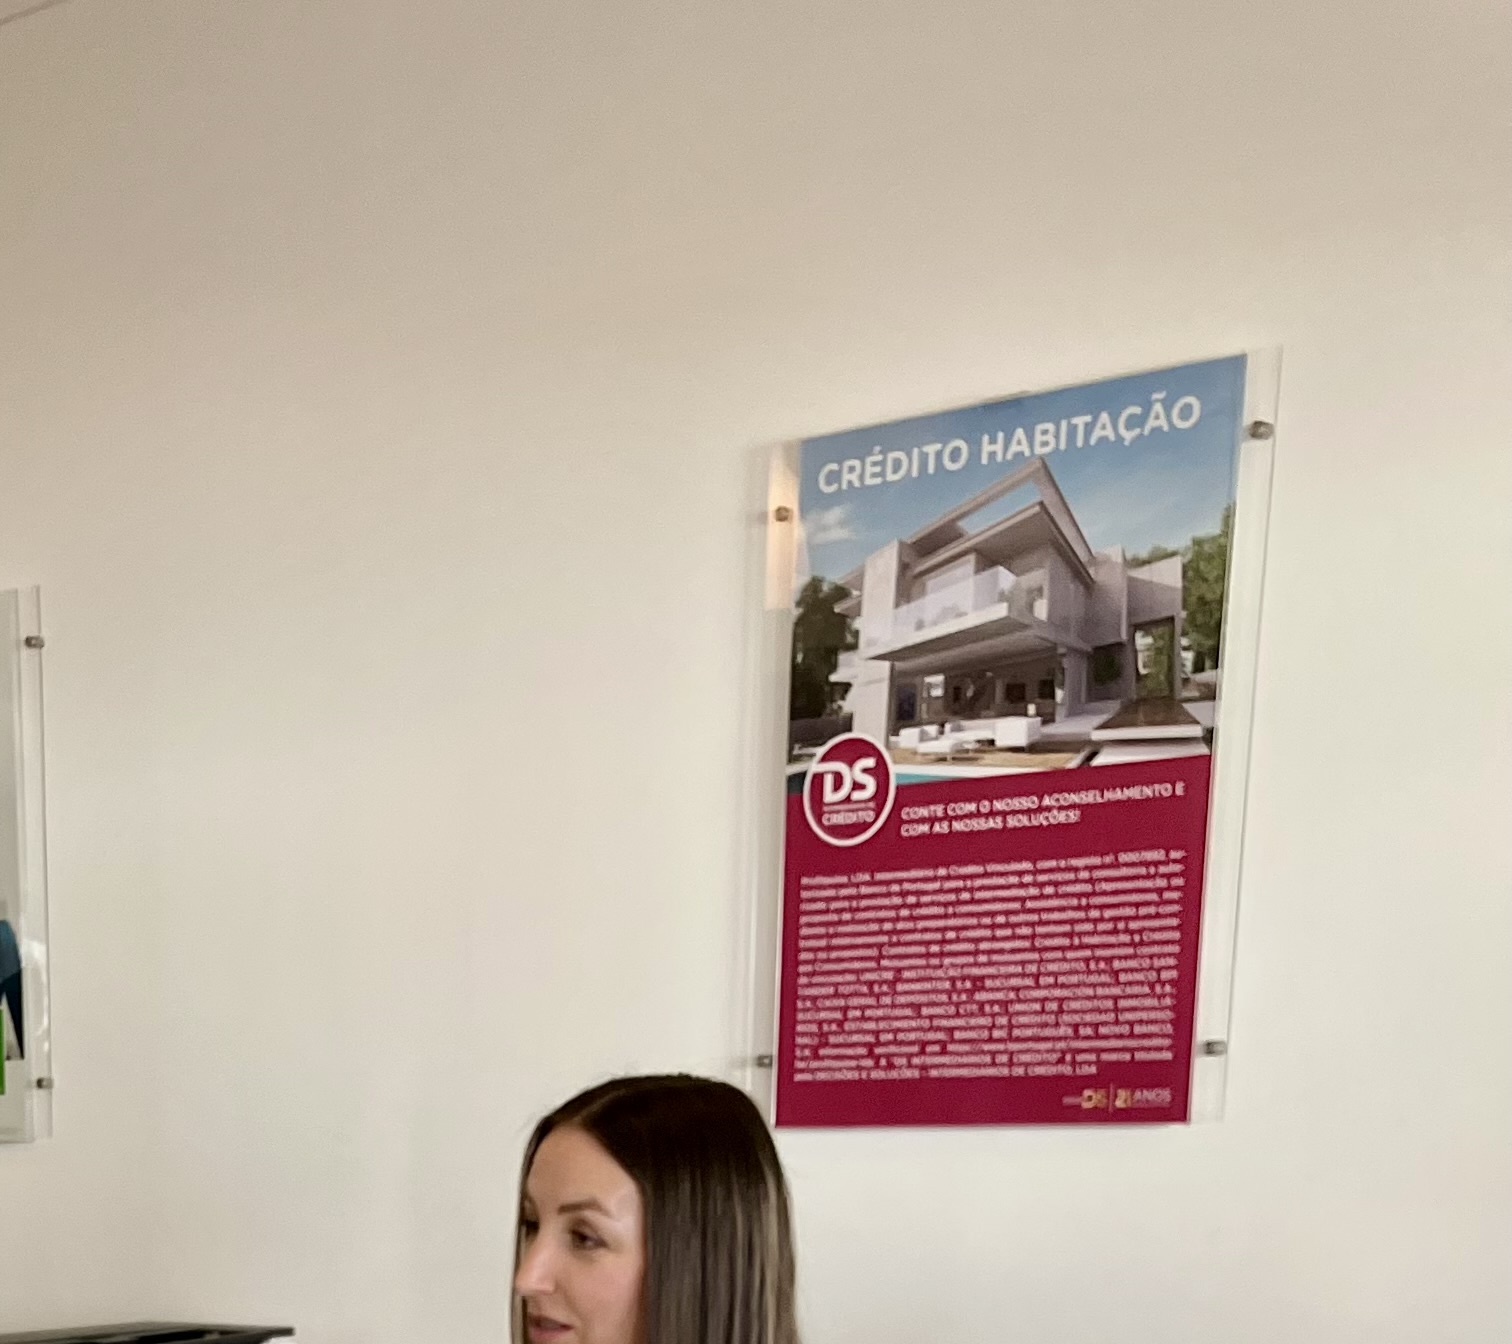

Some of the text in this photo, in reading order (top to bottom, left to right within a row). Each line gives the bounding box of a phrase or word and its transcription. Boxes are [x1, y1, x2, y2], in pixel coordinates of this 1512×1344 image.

[818, 391, 1202, 494] CRÉDITO HABITAÇÃO
[820, 757, 877, 804] DS
[901, 780, 1185, 820] CONTE COM O NOSSO ACONSELHAMENTO E
[901, 823, 931, 837] COM
[932, 820, 950, 834] AS
[951, 815, 1004, 832] NOSSAS
